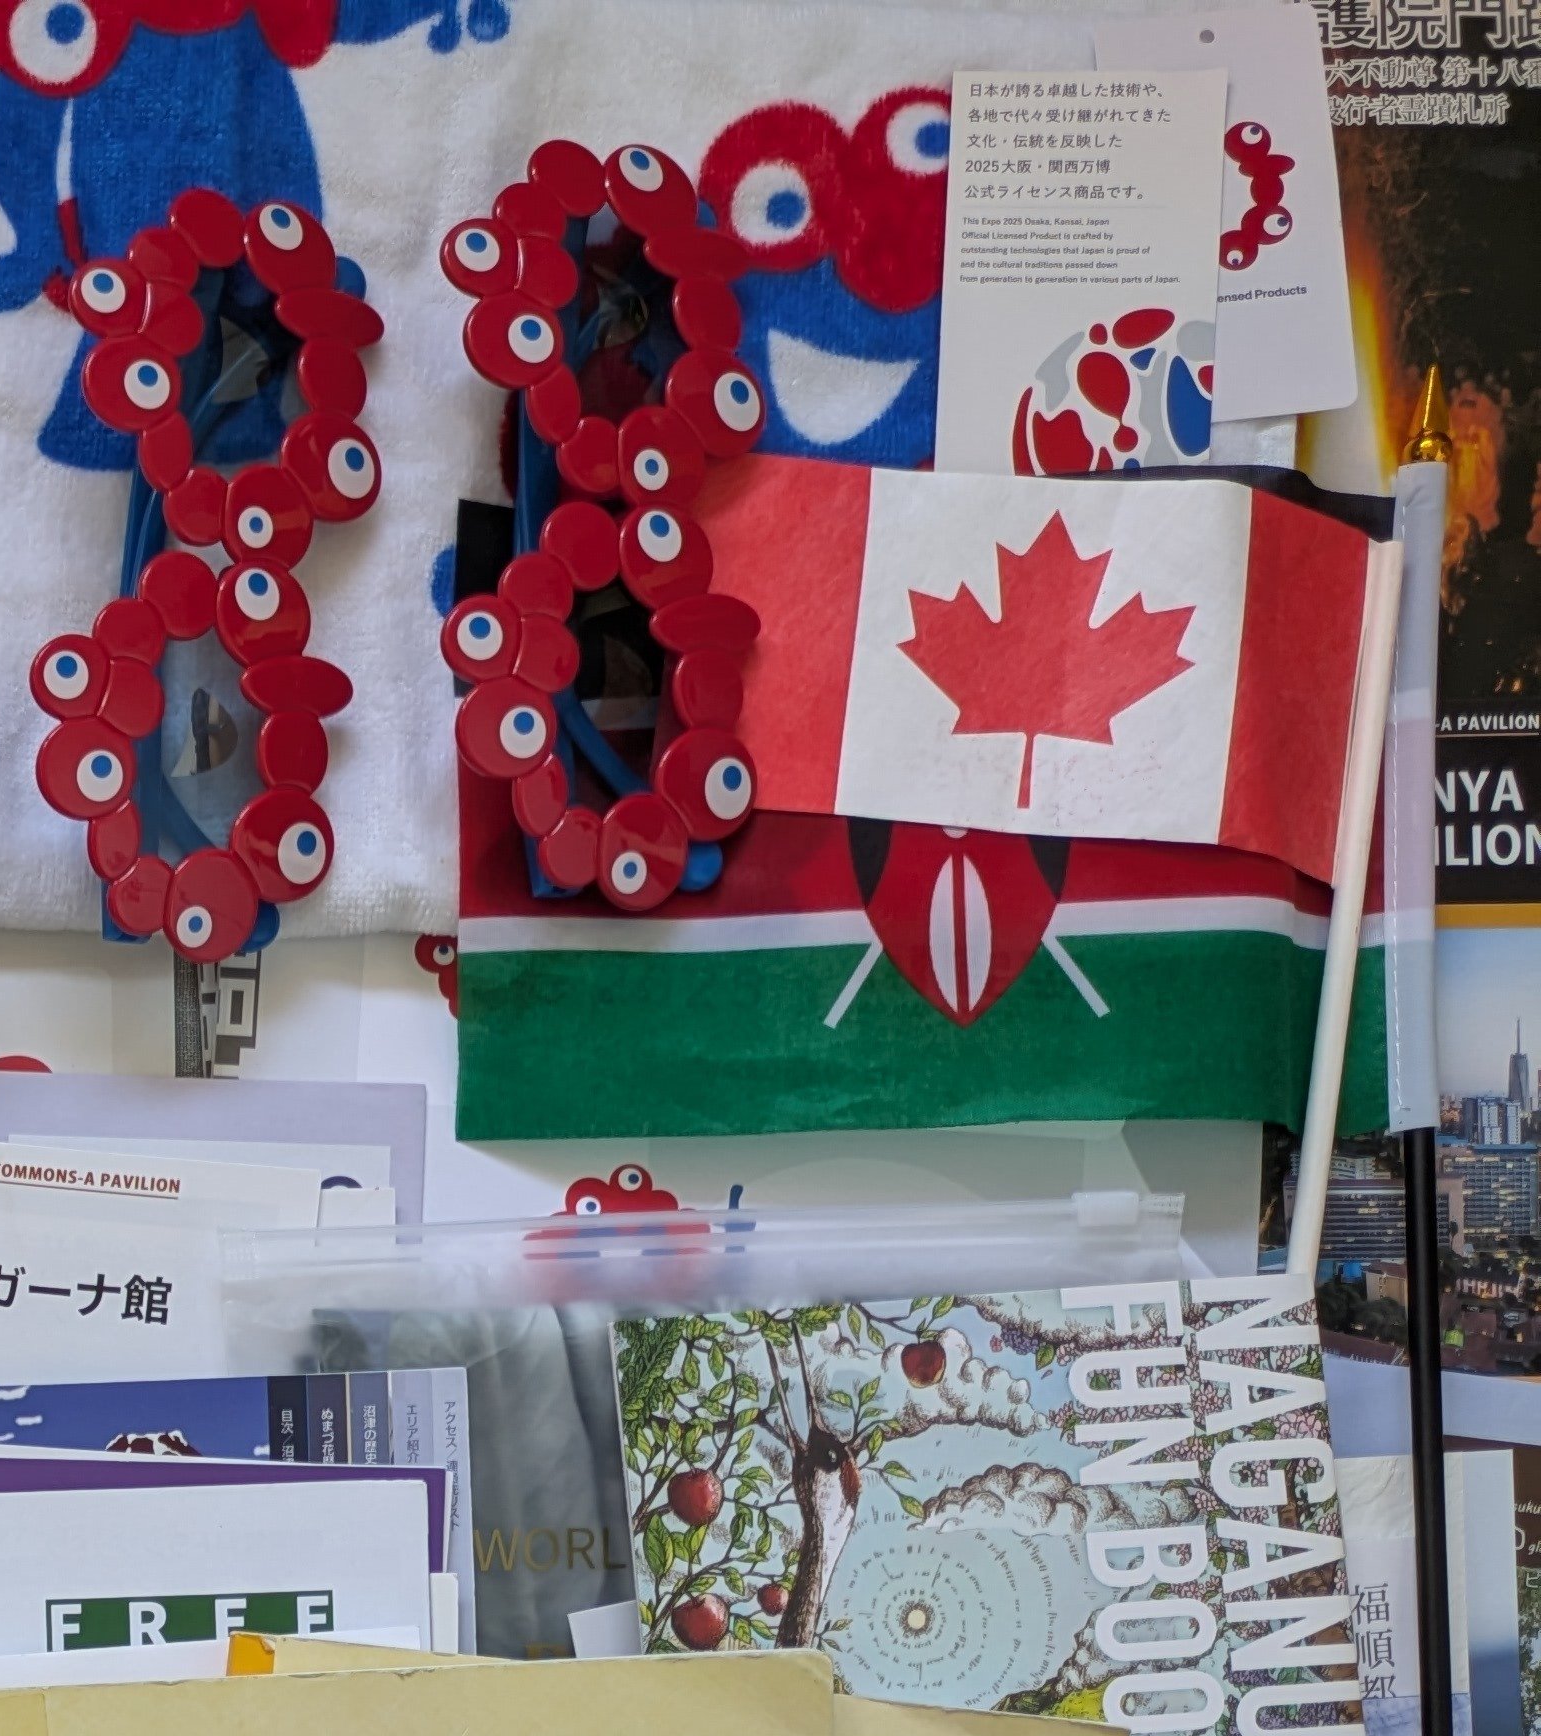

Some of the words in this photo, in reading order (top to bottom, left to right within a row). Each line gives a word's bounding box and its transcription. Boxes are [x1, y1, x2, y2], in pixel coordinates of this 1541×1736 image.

[967, 133, 1123, 149] 文化・伝統を反映した
[965, 158, 1111, 174] 2025大阪・関西万博
[964, 184, 1144, 200] 公式ライセンス商品です。
[1457, 714, 1540, 732] PAVILION
[100, 1170, 182, 1195] PAVILION
[1060, 1285, 1200, 1489] FUN
